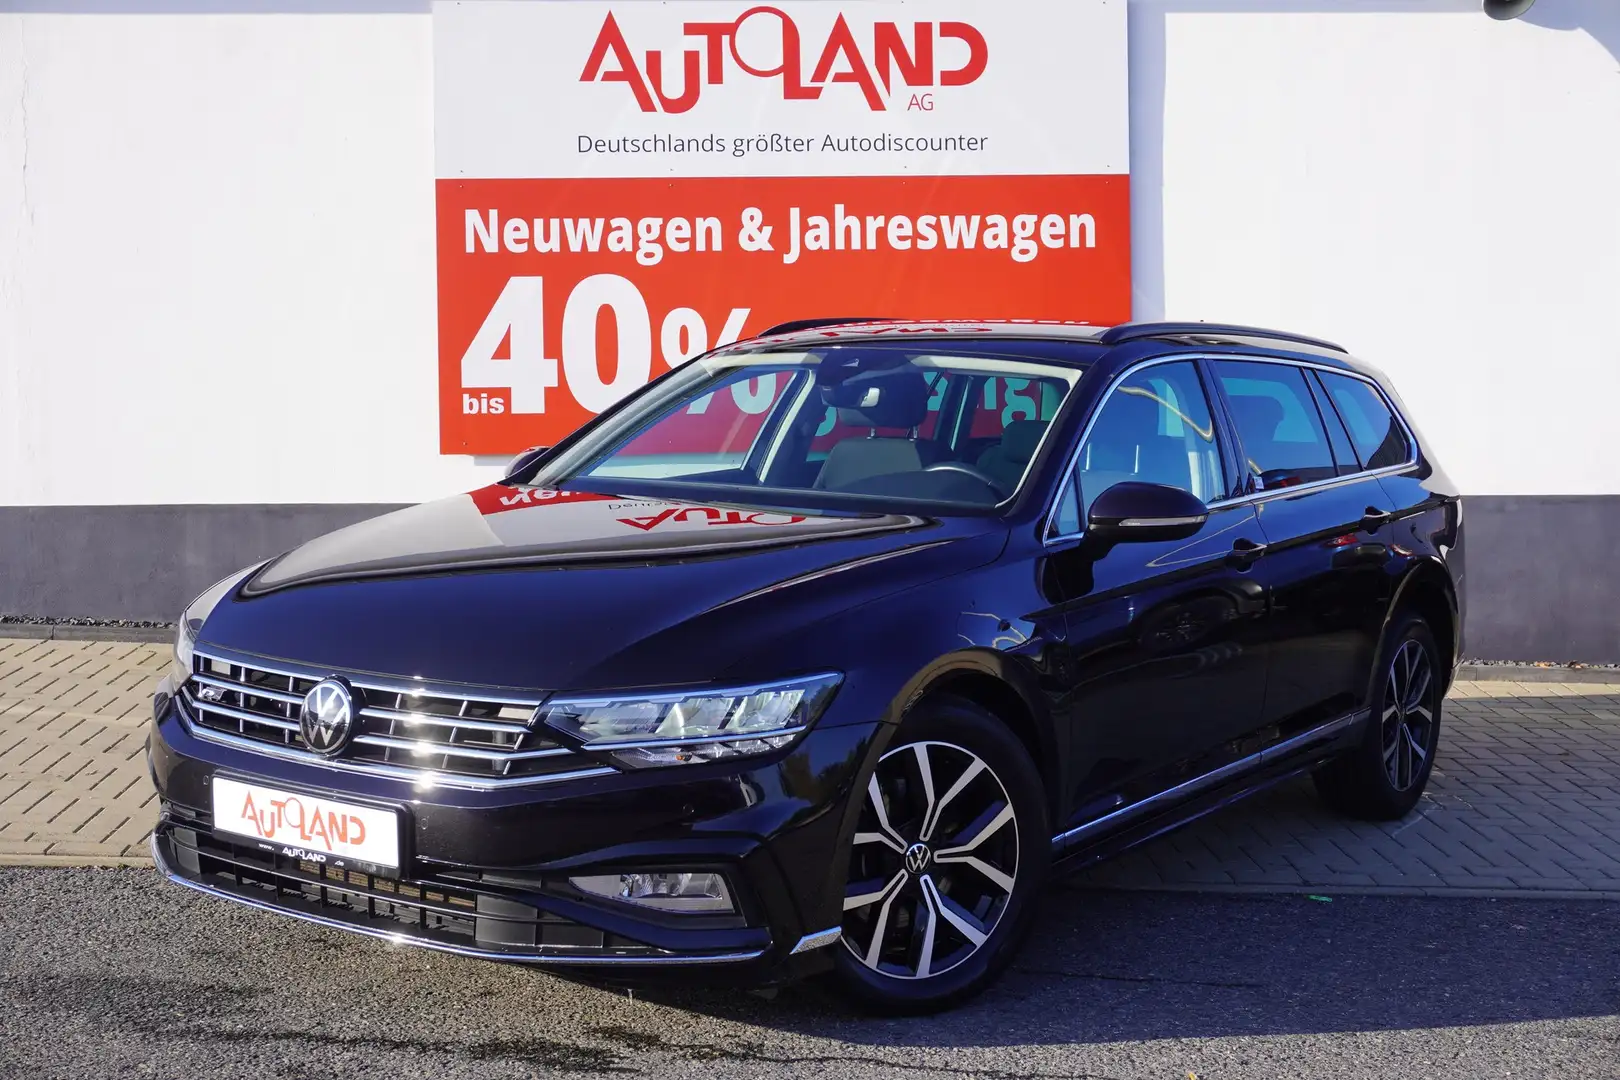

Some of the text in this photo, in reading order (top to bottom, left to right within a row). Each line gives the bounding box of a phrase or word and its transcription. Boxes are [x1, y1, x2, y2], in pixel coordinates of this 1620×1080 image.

[579, 5, 989, 114] AUTOLAND
[907, 93, 934, 112] AG
[578, 133, 989, 158] Deutschlands größter Autodiscounter
[464, 203, 1096, 266] Neuwagen & Jahreswagen
[462, 393, 505, 415] bis
[241, 792, 365, 849] AUTOLAND
